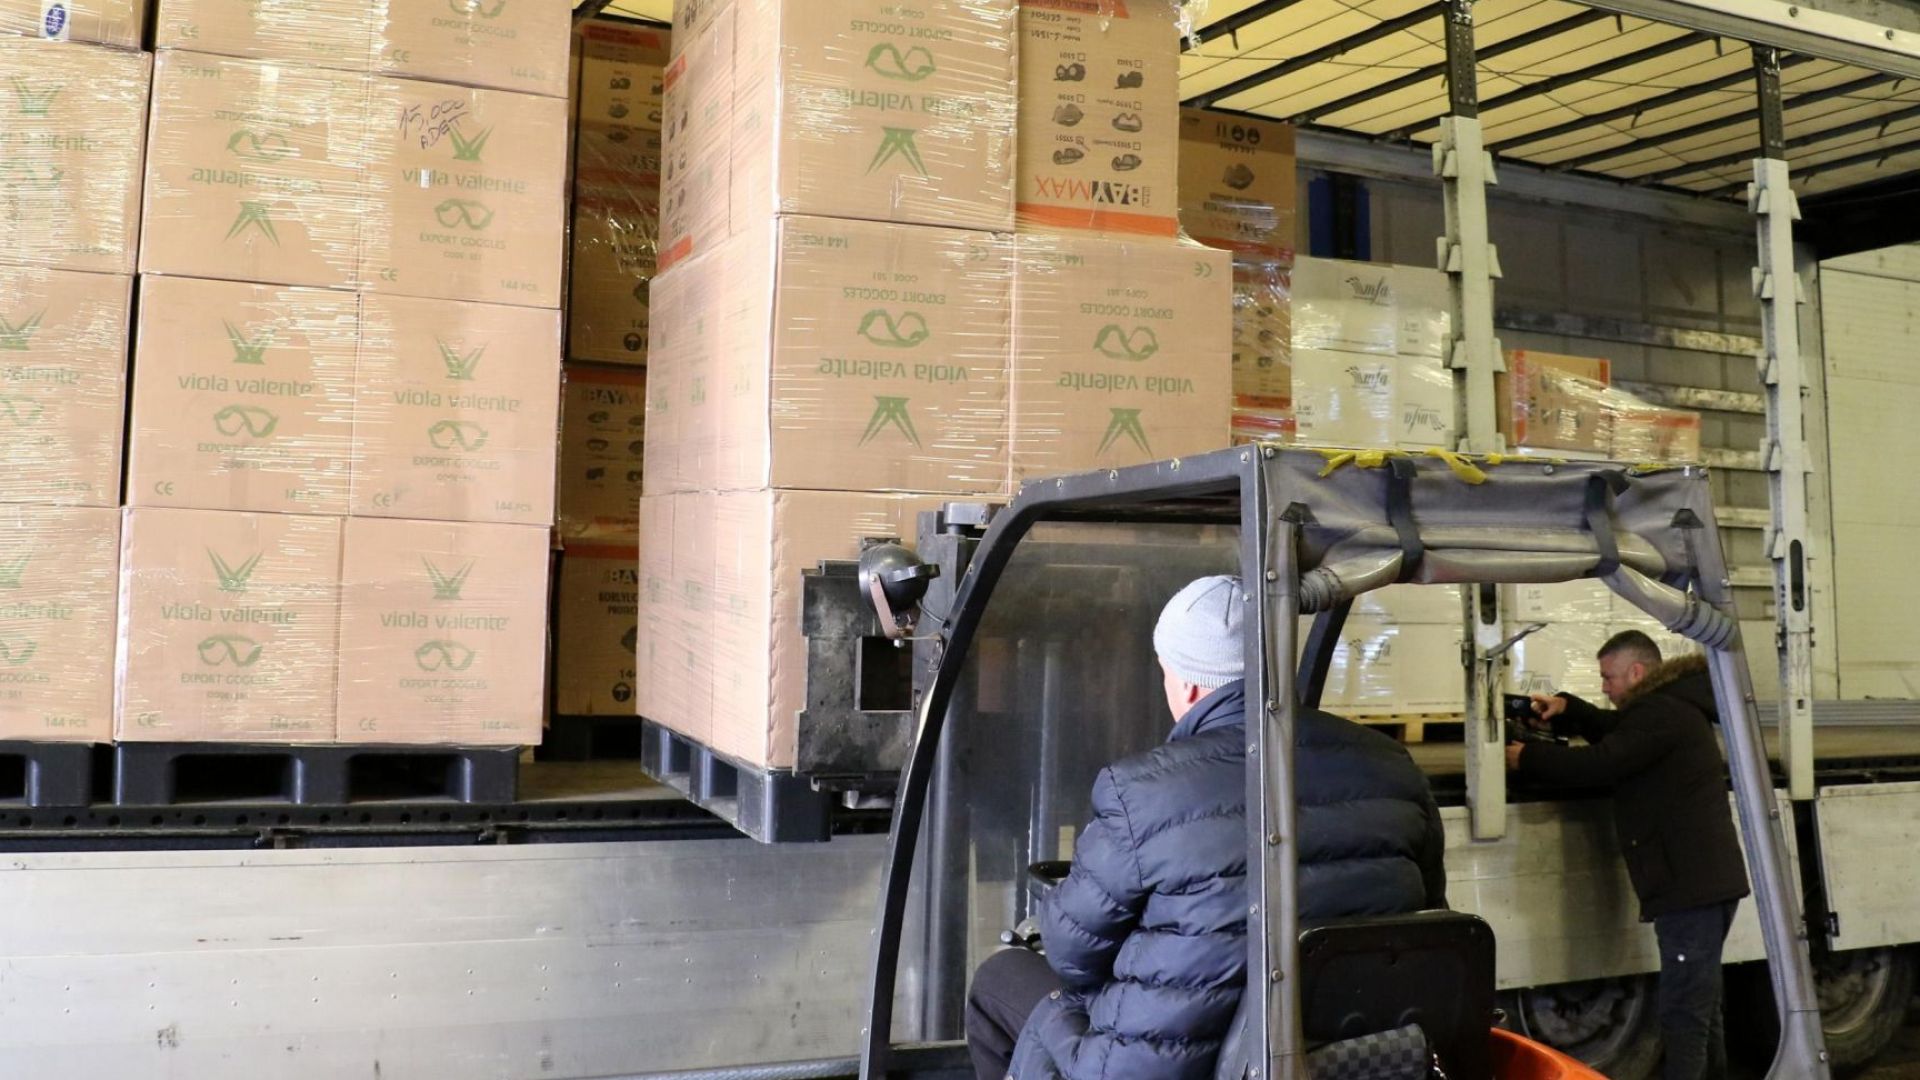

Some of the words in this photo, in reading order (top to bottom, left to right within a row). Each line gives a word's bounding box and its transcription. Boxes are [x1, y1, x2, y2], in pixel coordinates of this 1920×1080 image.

[850, 20, 905, 35] GOGGLES
[456, 172, 527, 194] valente
[827, 236, 849, 249] 144
[843, 286, 898, 301] GOGGLES
[901, 290, 947, 305] EXPORT
[1080, 302, 1130, 318] GOGGLES
[1133, 305, 1174, 320] EXPORT
[818, 357, 908, 380] valente
[914, 362, 969, 386] viola
[178, 372, 229, 393] viola
[235, 377, 314, 398] valente
[1057, 370, 1139, 392] valente
[1145, 375, 1195, 397] viola
[394, 388, 442, 408] viola
[449, 392, 521, 413] valente
[154, 480, 174, 496] CE
[371, 492, 391, 508] CE
[160, 602, 213, 622] viola
[220, 605, 298, 625] valente
[380, 610, 429, 629] viola
[435, 613, 508, 632] valente
[181, 672, 222, 685] EXPORT
[44, 716, 66, 729] 144
[358, 717, 378, 732] CE
